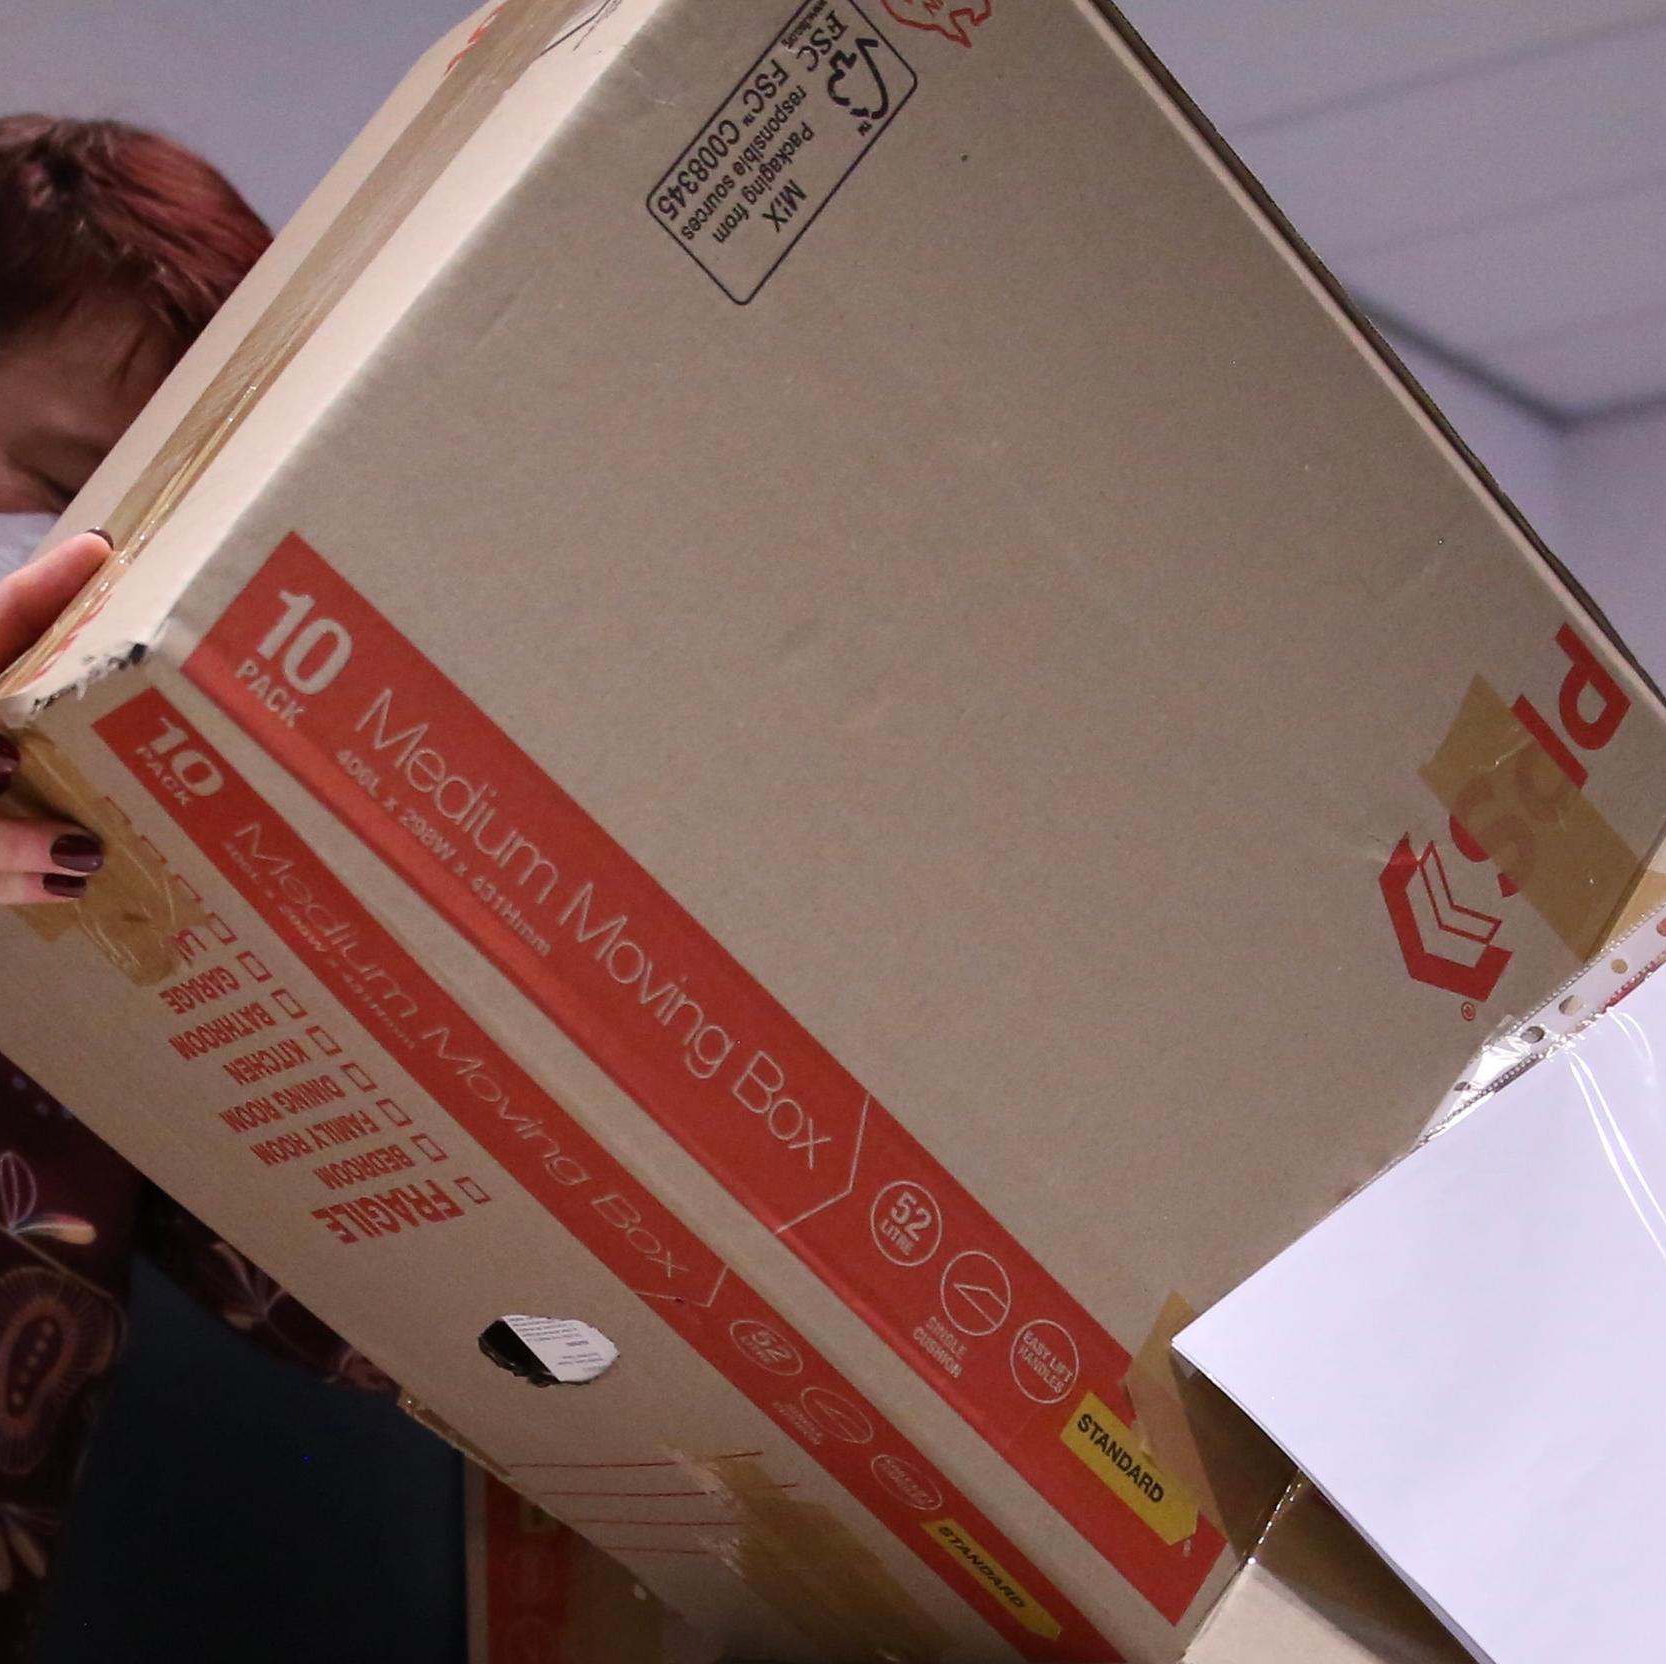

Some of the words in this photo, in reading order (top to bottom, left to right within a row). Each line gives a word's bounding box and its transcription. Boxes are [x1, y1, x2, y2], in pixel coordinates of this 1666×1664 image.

[796, 9, 848, 72] FSC
[734, 86, 807, 176] responsible
[657, 119, 740, 221] C008345
[741, 122, 815, 204] Packaging
[682, 175, 735, 241] sources
[712, 206, 751, 243] from
[256, 590, 353, 696] 10
[234, 659, 310, 728] PACK
[134, 745, 191, 807] PACK
[147, 716, 225, 797] 10
[354, 687, 560, 905] Medium
[559, 883, 735, 1080] Moving
[733, 1050, 833, 1171] Box
[159, 965, 240, 1015] GARAGE
[167, 1001, 276, 1061] BATHROOM
[222, 1038, 311, 1086] KITCHEN
[233, 822, 420, 1018] Medium
[421, 1025, 590, 1187] Moving
[591, 1194, 687, 1280] Box
[219, 1097, 285, 1133] ROOM
[281, 1074, 346, 1115] DINING
[249, 1131, 314, 1167] ROOM
[306, 1110, 381, 1150] FAMILY
[313, 1144, 416, 1190] BEDROOM
[311, 1179, 465, 1244] FRAGILE
[890, 1192, 932, 1242] 52
[1023, 1330, 1053, 1364] EASY
[1049, 1357, 1075, 1382] LIFT
[1077, 1413, 1165, 1505] STANDARD
[937, 1525, 1027, 1610] STANDARD
